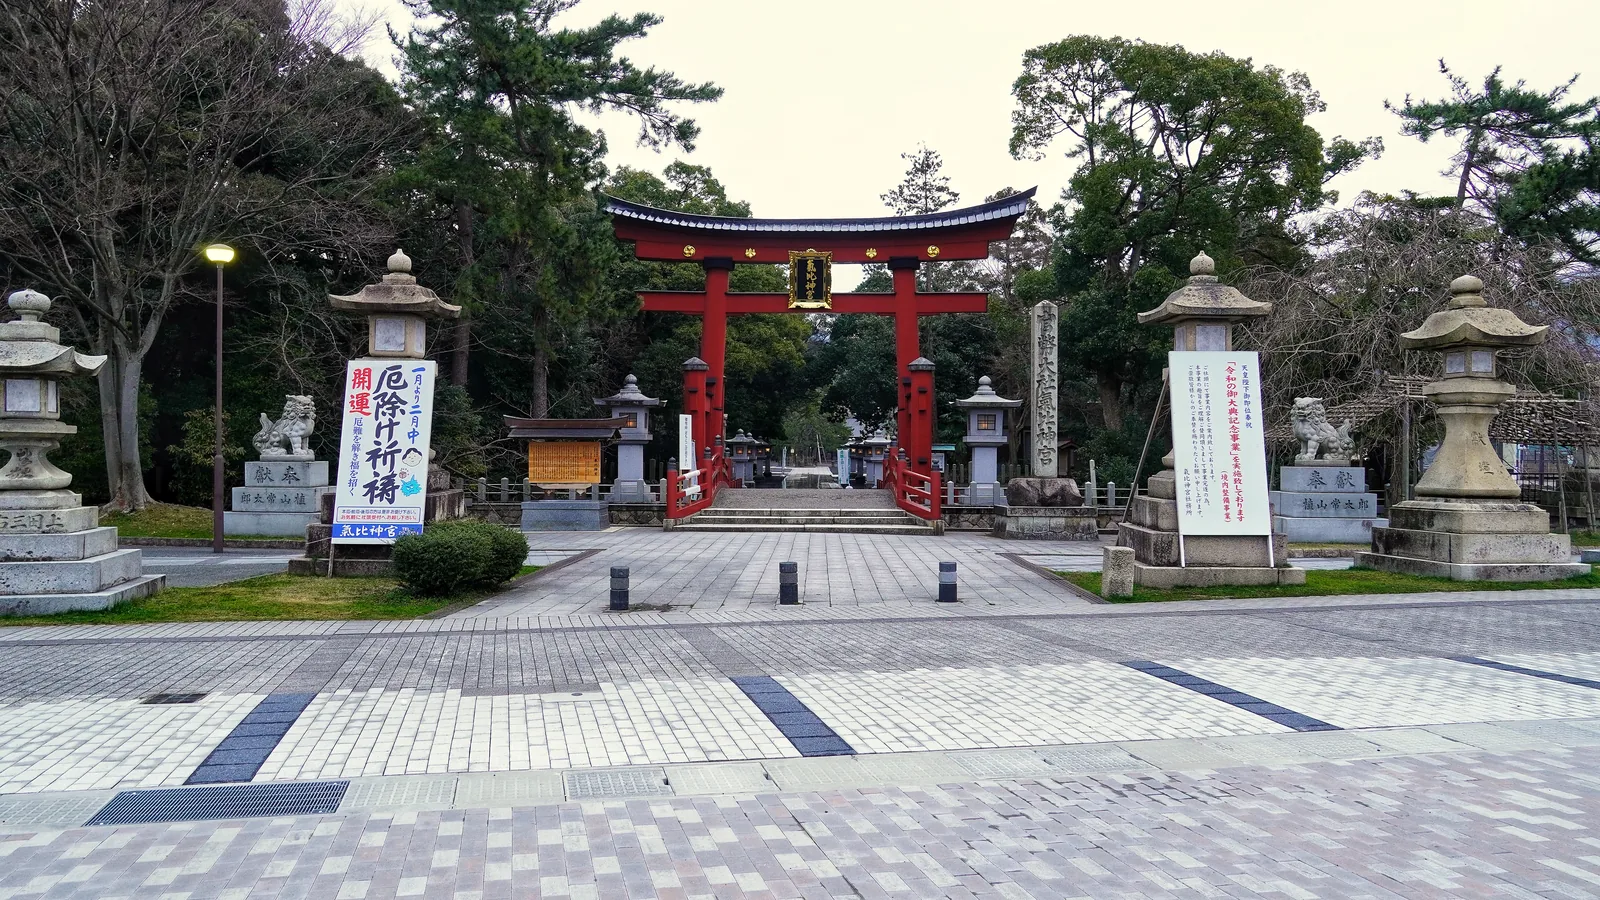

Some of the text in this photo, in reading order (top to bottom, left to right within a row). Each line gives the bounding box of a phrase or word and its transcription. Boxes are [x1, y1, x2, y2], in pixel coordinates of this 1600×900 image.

[349, 367, 372, 416] 開運
[407, 367, 426, 444] 一月より二月中
[1036, 310, 1057, 467] 官幣大社氣比神宮
[1241, 365, 1253, 429] 天皇陛下御即位奉祝
[362, 364, 408, 505] 厄除け祈祷
[340, 525, 398, 537] 氣比神宮
